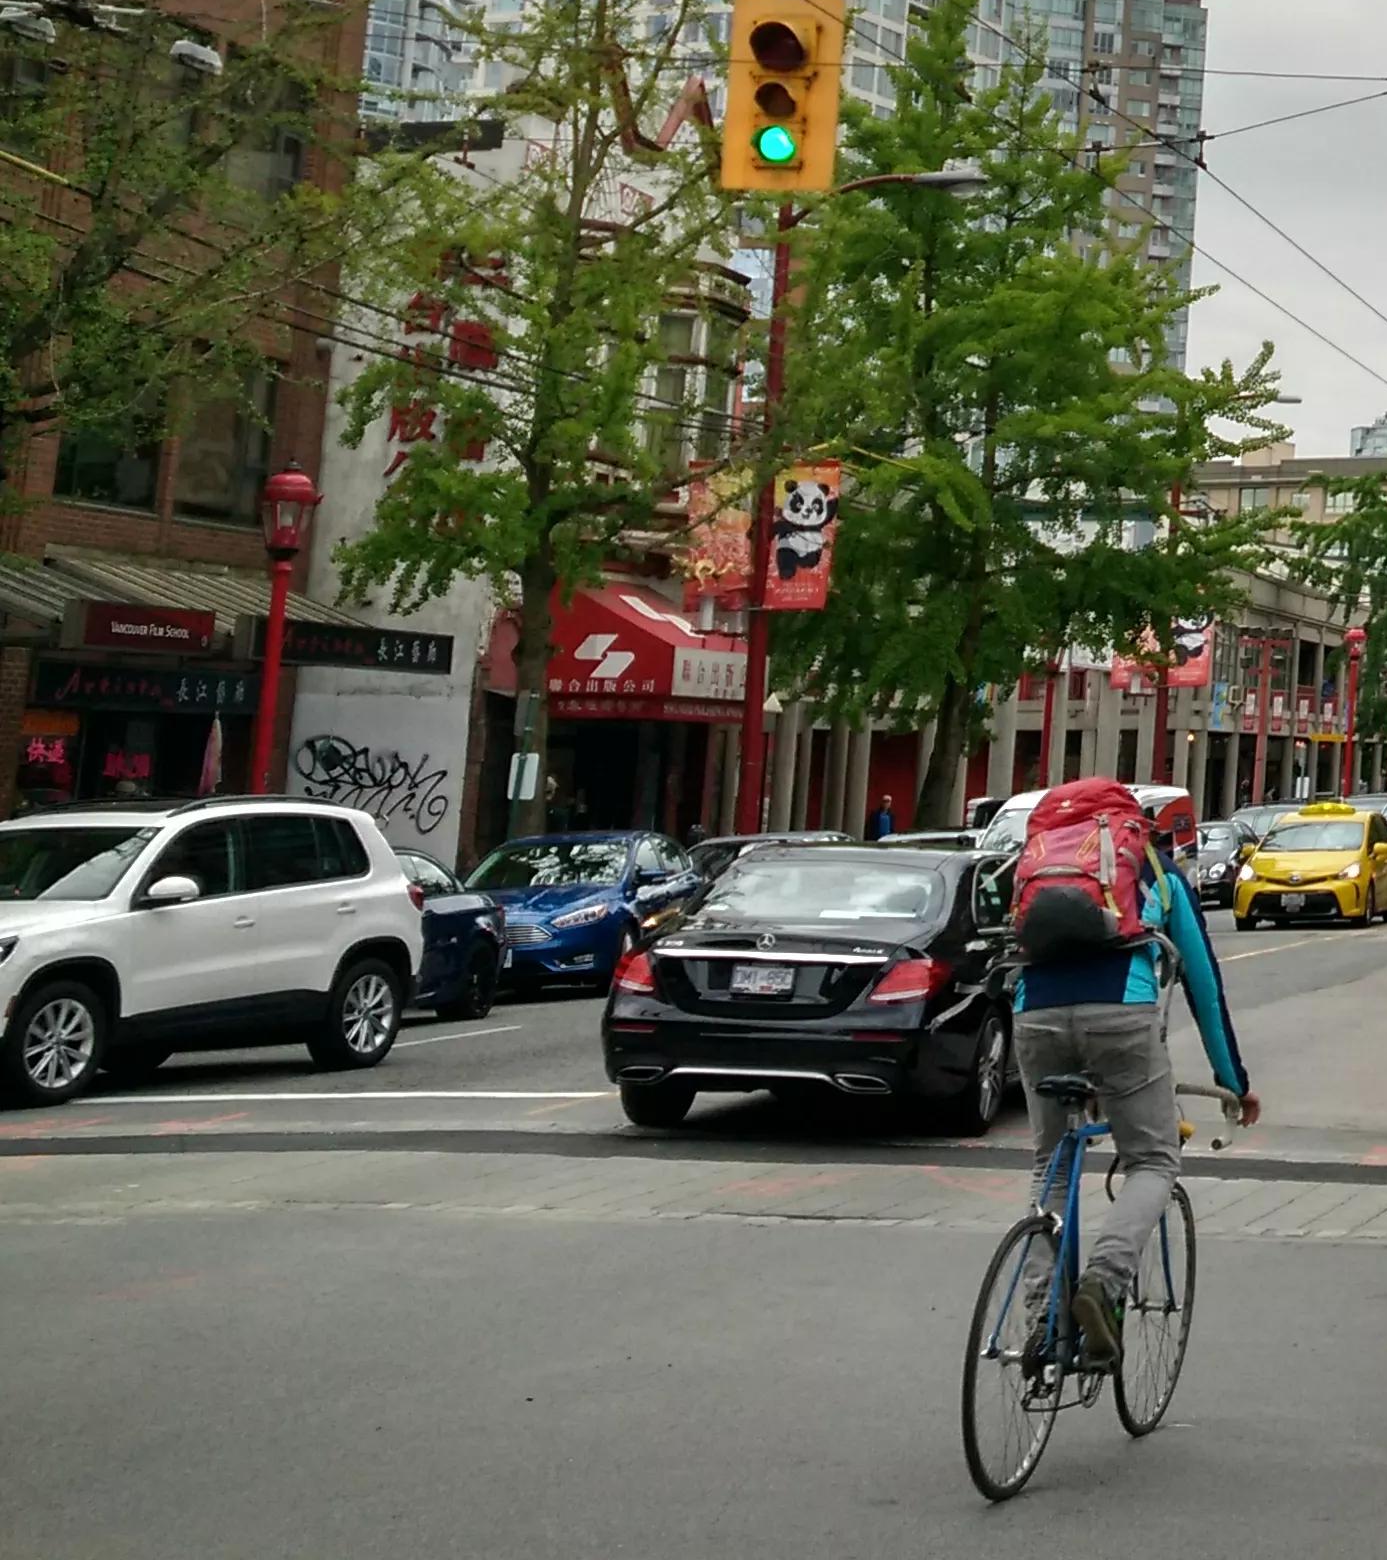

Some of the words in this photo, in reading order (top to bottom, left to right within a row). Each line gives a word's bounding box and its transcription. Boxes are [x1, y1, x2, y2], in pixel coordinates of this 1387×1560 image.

[111, 621, 148, 636] VANCOUVER
[149, 624, 165, 637] FILM
[166, 625, 189, 639] SCHOOL
[549, 678, 656, 694] 聯合出版公司
